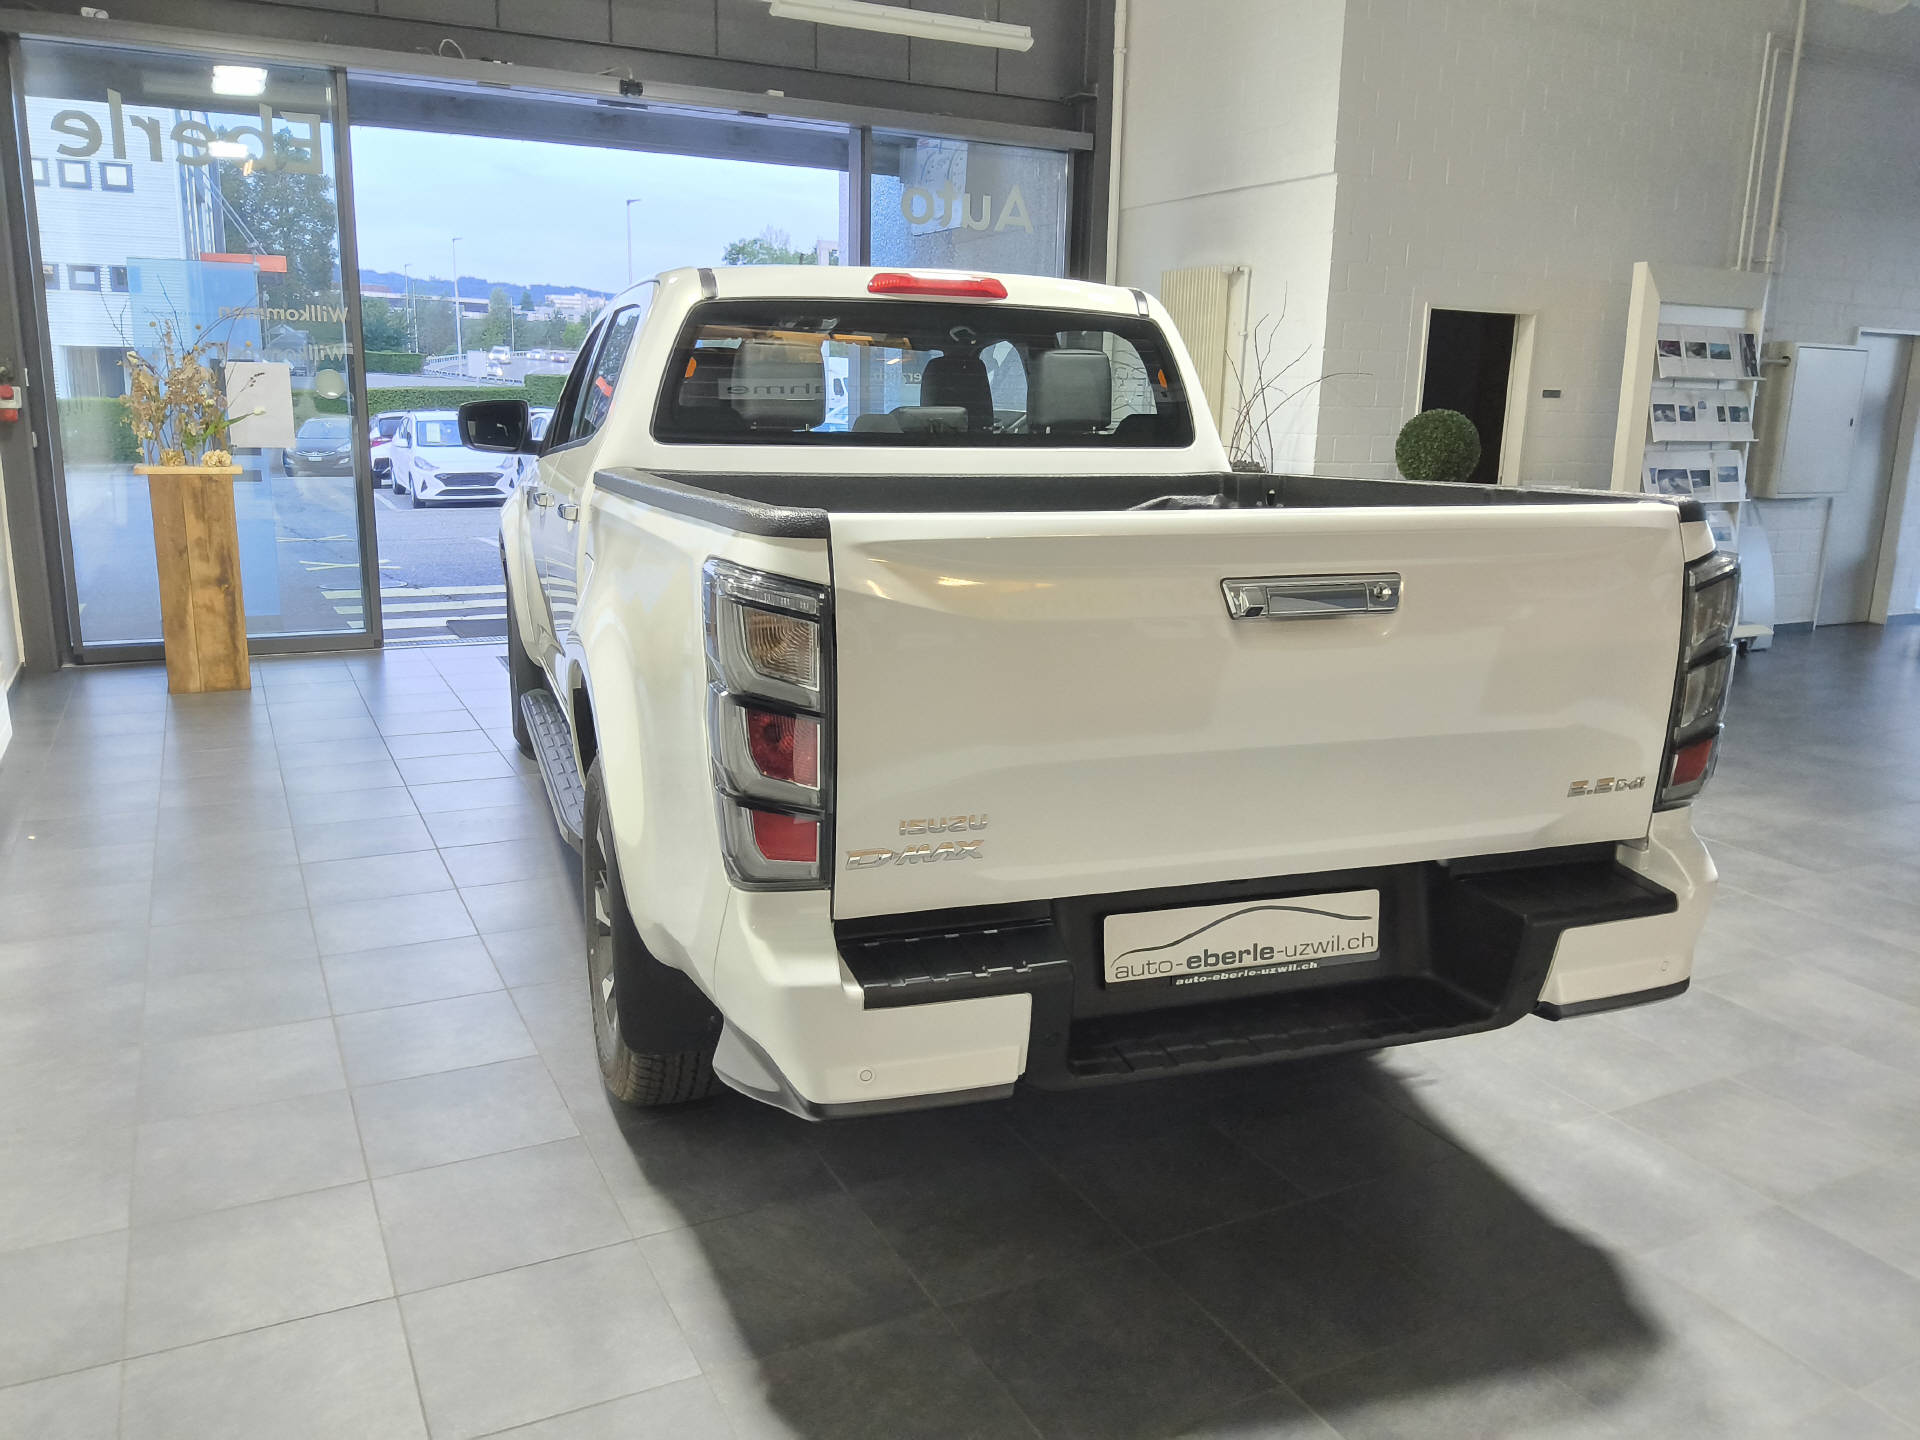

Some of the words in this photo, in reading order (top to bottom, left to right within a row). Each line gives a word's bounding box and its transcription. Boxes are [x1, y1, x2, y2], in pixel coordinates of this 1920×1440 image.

[898, 813, 989, 836] ISUZU
[845, 839, 985, 871] D-MAX
[1114, 931, 1375, 980] auto-eberle-uzwil.ch
[1175, 961, 1318, 986] auto-eberle-uzwil.ch
